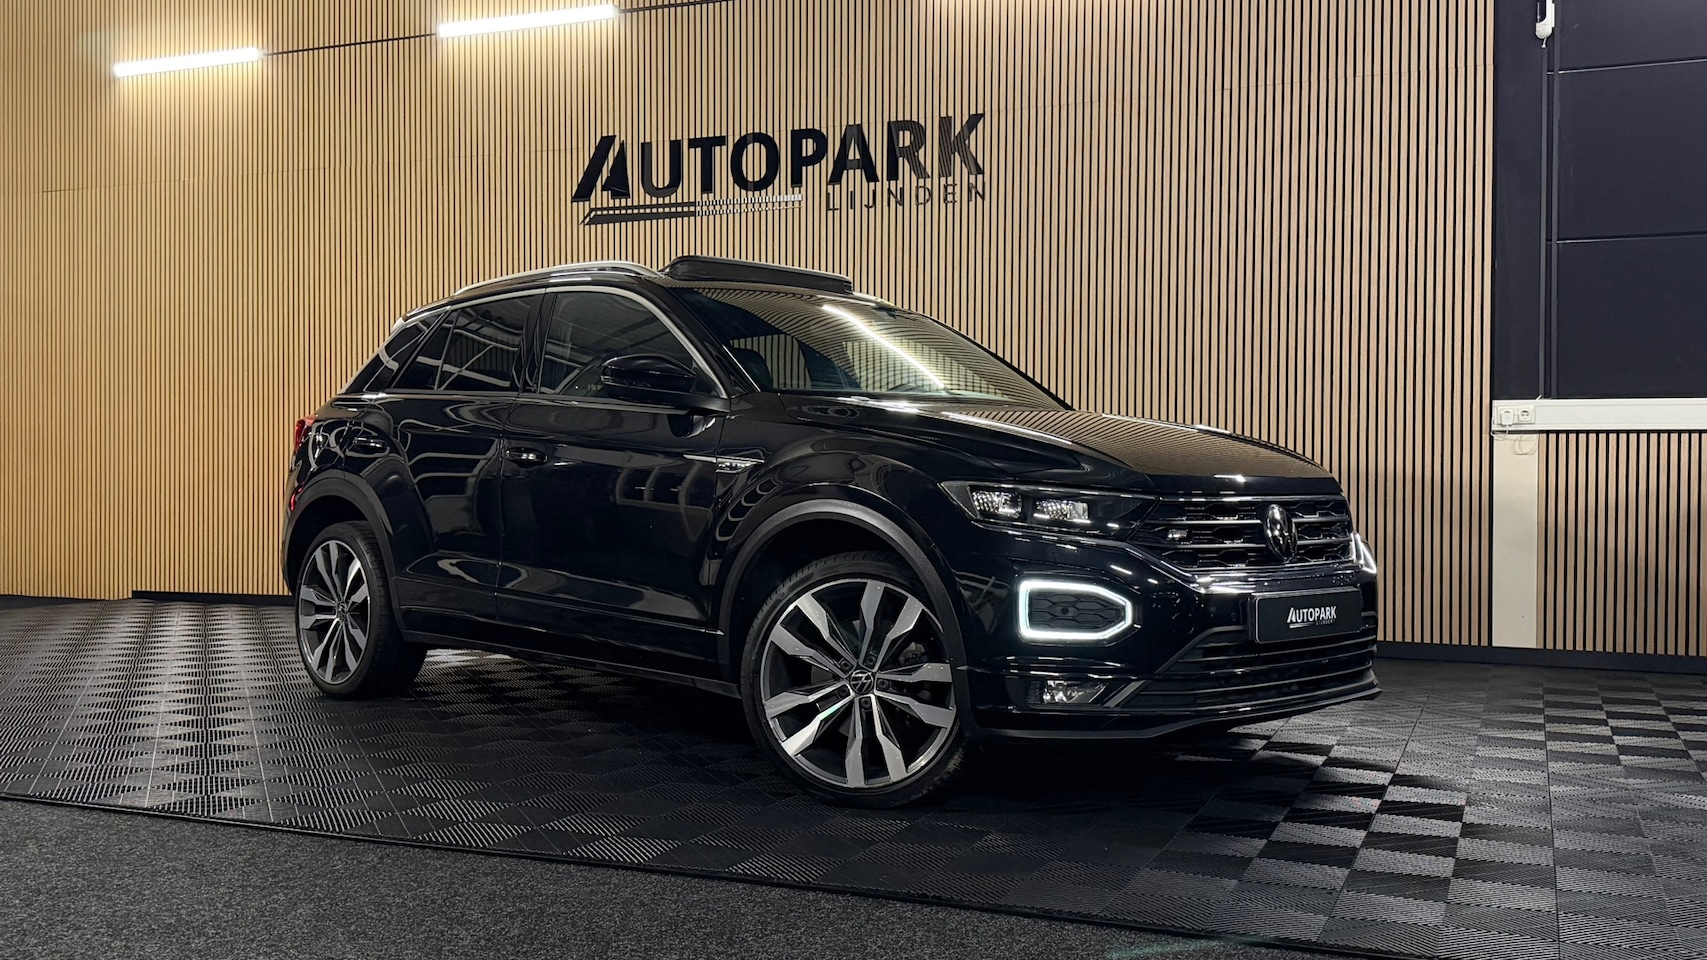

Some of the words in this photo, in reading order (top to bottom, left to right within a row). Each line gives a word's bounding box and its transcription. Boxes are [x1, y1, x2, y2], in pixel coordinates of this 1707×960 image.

[571, 113, 985, 202] AUTOPARK
[827, 181, 986, 211] LIJNDEN
[1286, 605, 1337, 624] AUTOPARK
